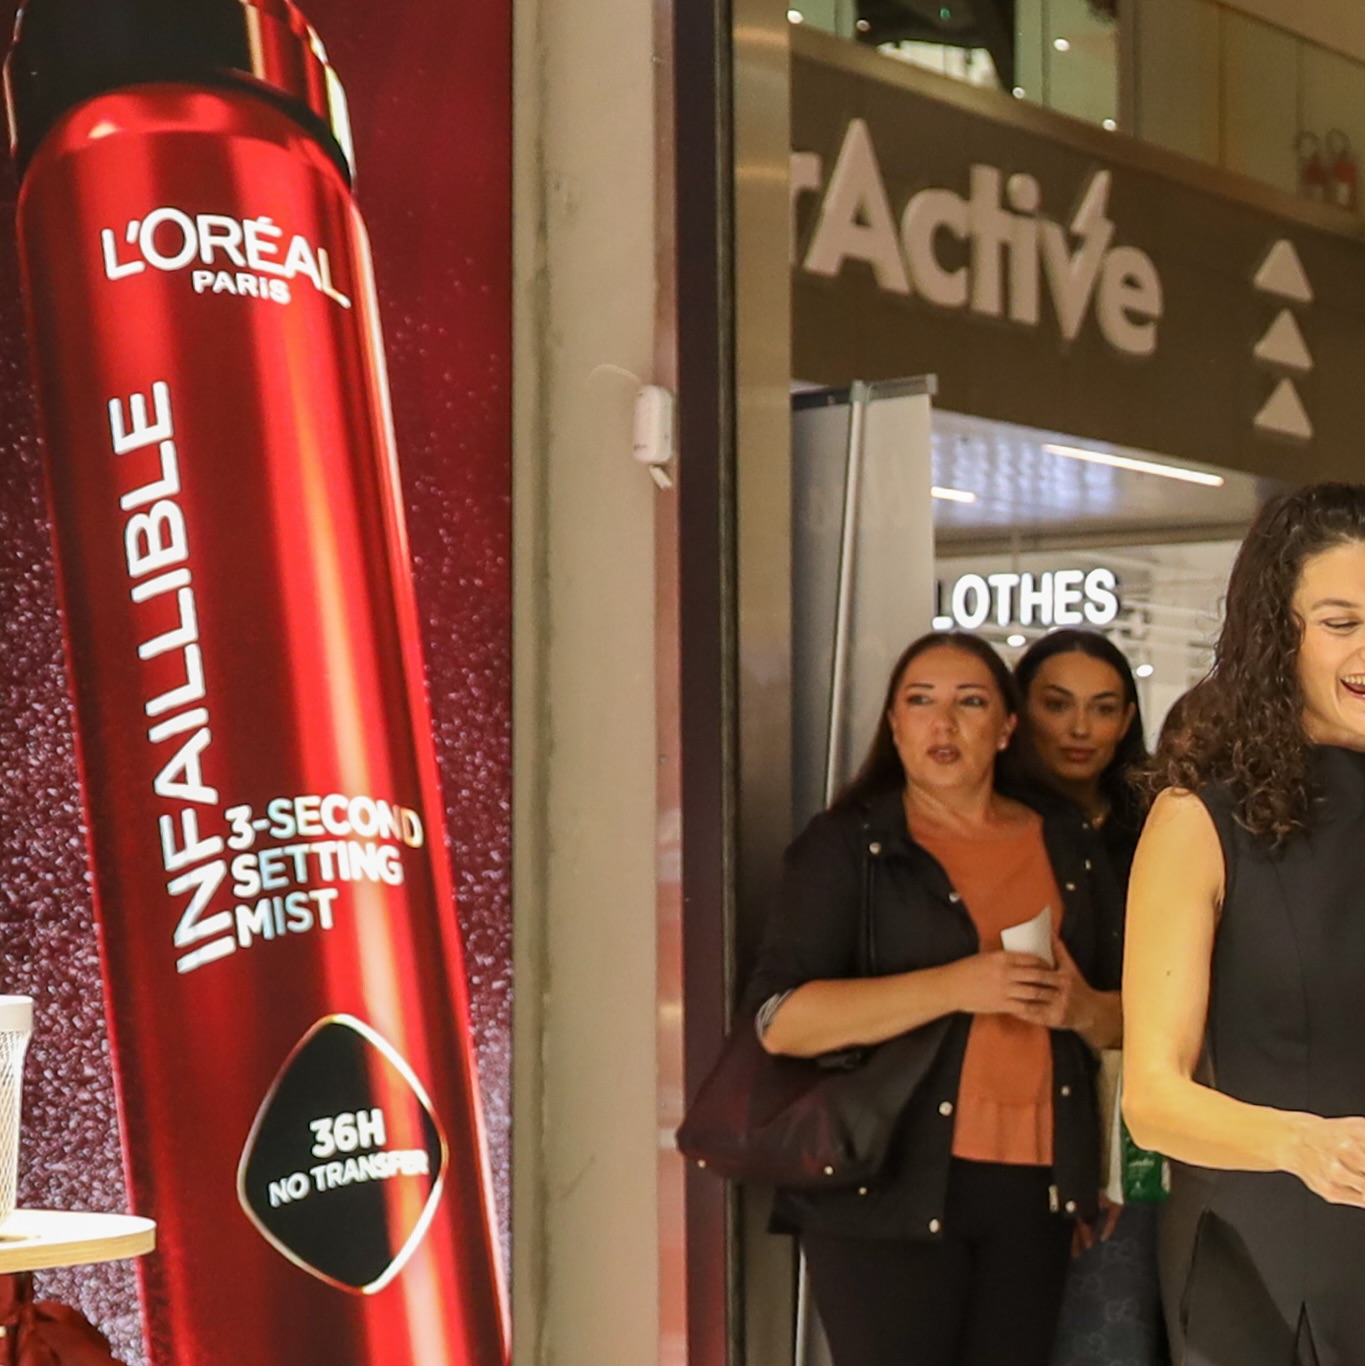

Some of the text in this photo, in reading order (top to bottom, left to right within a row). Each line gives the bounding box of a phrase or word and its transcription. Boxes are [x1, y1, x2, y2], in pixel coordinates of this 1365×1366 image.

[101, 206, 352, 309] L'ORÉAL
[192, 270, 292, 305] PARIS
[109, 380, 237, 975] INFAILLIBLE
[224, 793, 424, 848] 3-SECOND
[230, 840, 405, 898] SETTING
[234, 888, 339, 948] MIST
[309, 1108, 387, 1158] 36H
[268, 1149, 430, 1208] NO TRANSFER
